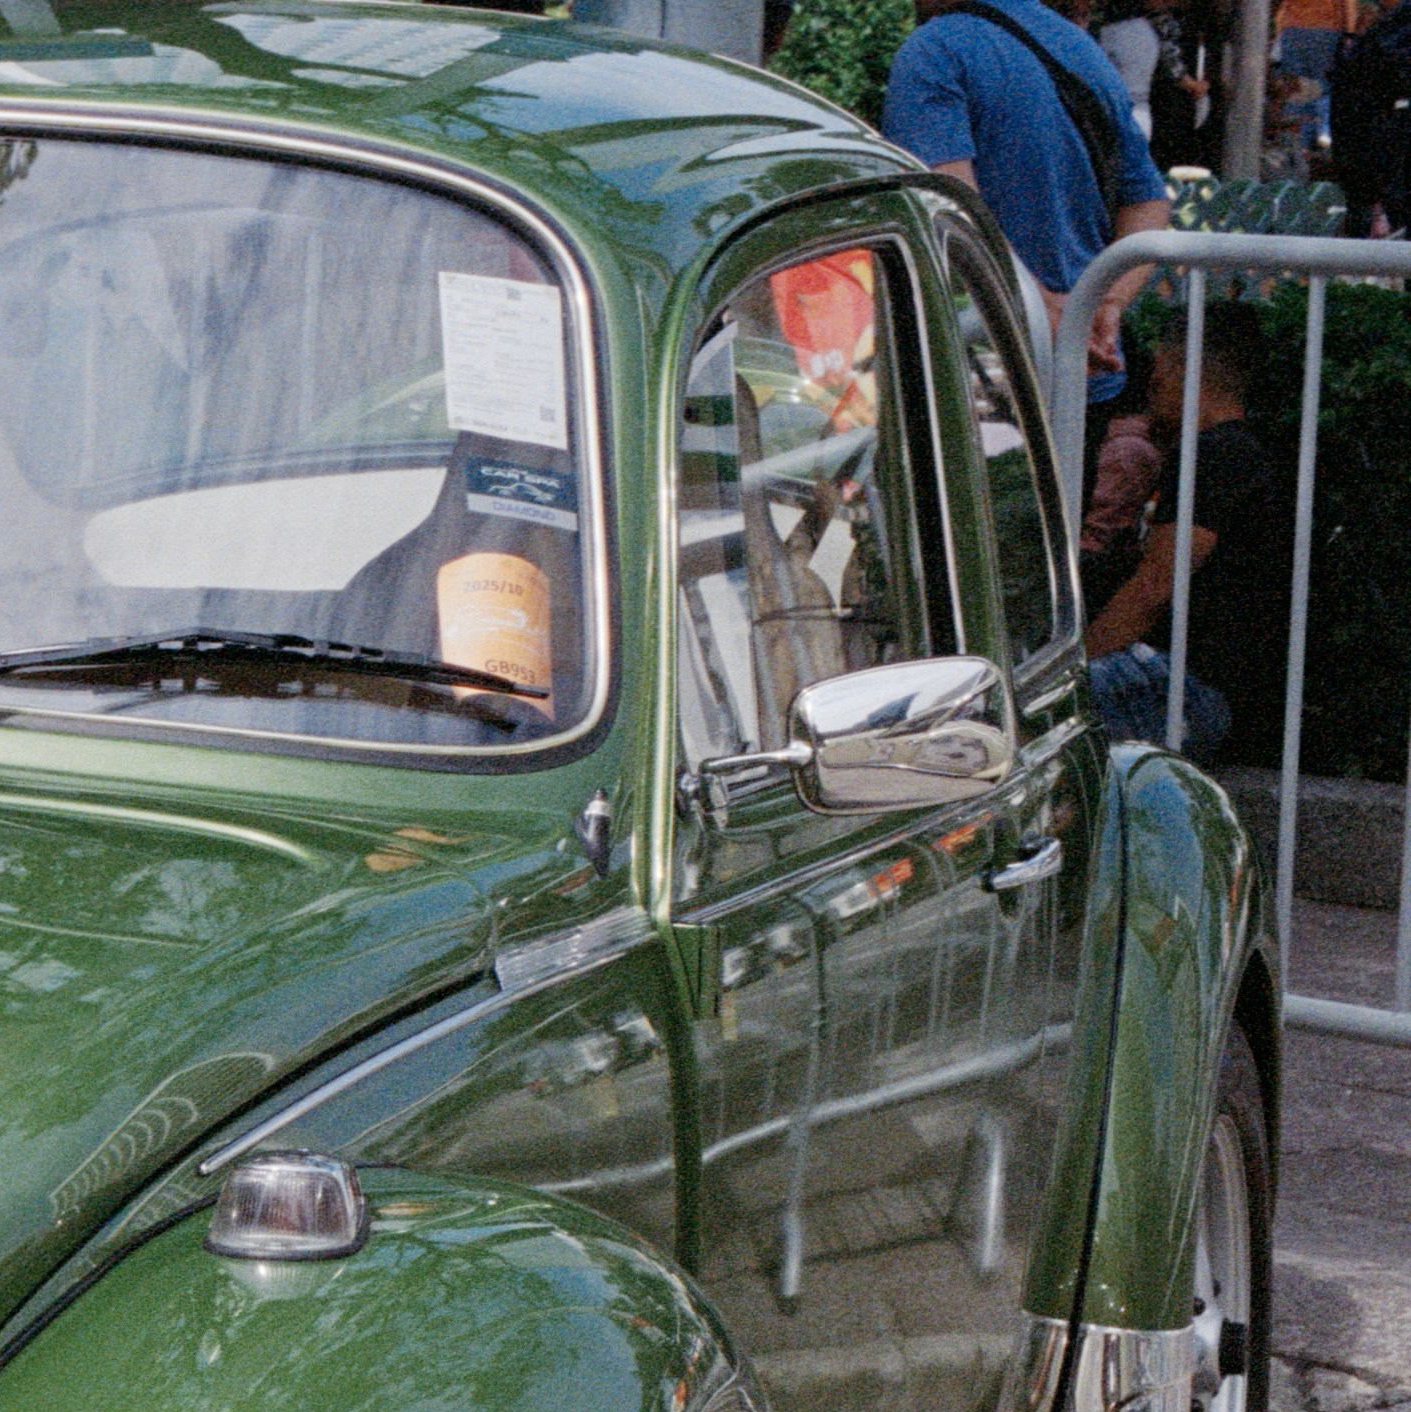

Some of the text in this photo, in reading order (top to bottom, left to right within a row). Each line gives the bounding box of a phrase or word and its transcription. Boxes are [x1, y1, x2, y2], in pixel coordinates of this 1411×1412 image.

[492, 501, 555, 521] DIAMOND
[464, 579, 523, 596] 2025/10
[485, 659, 536, 684] GB953
